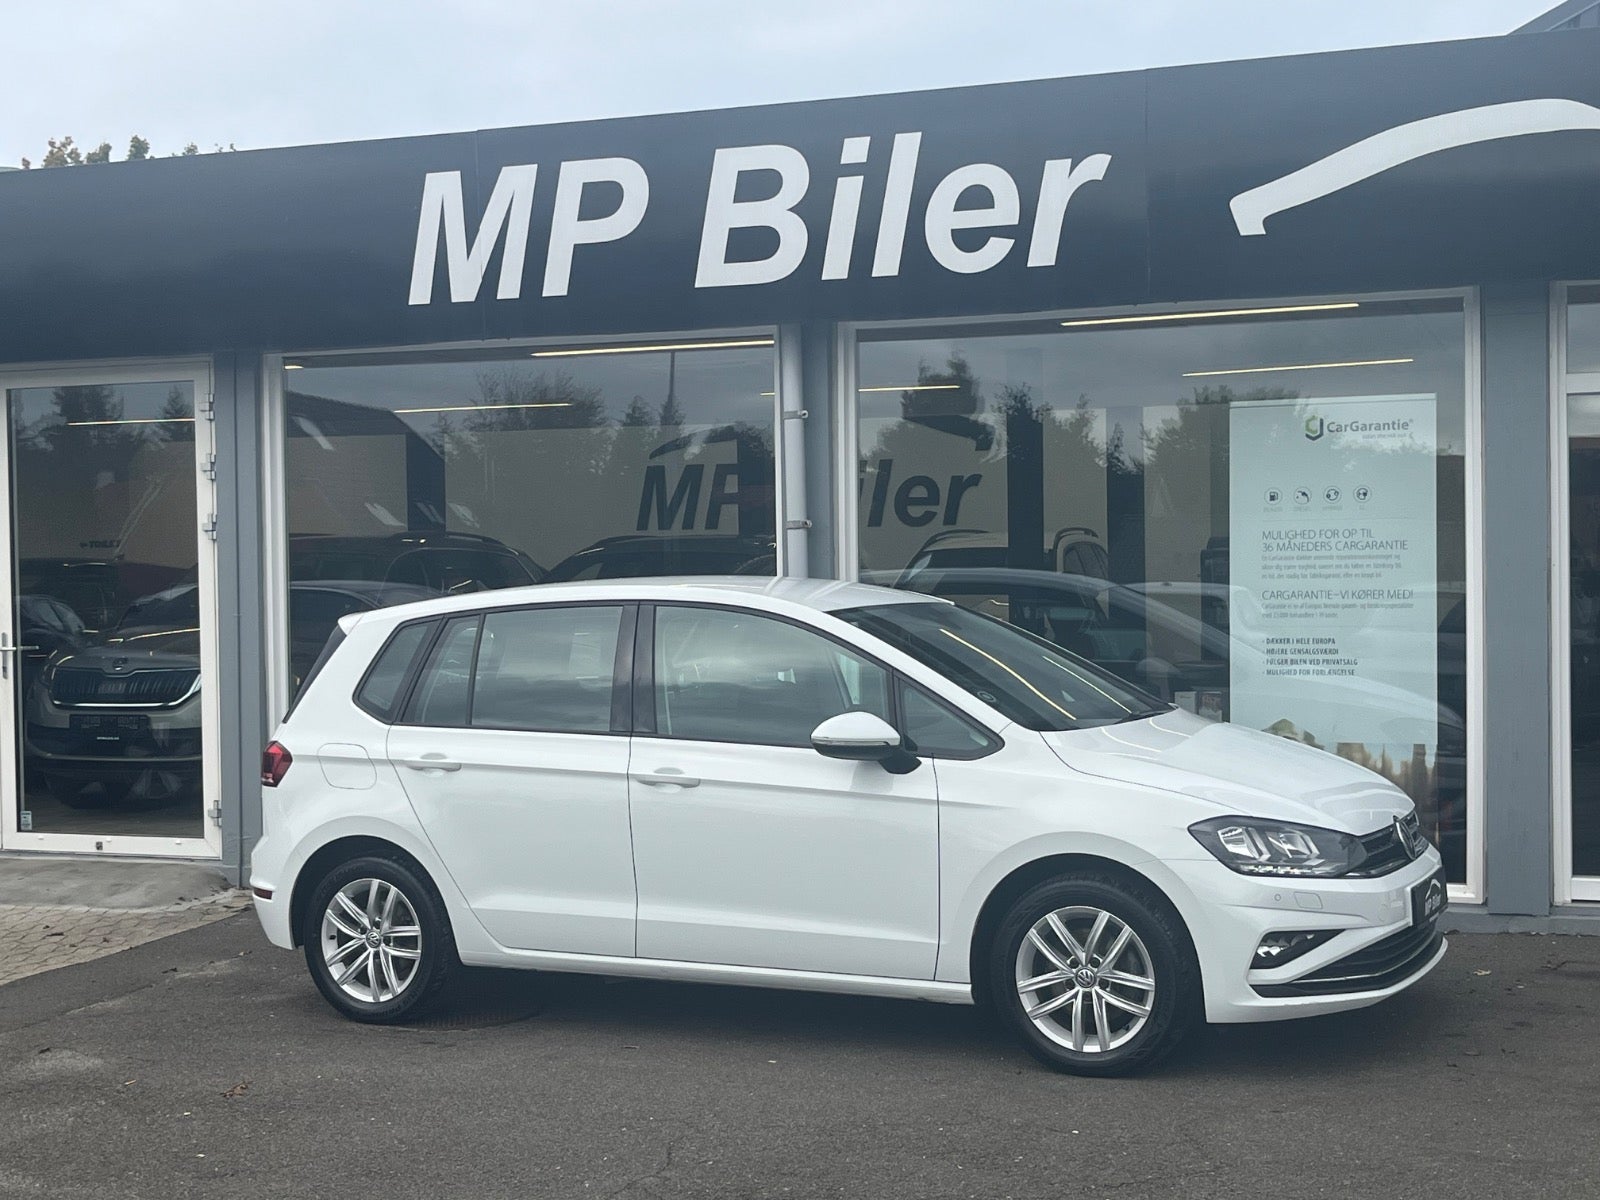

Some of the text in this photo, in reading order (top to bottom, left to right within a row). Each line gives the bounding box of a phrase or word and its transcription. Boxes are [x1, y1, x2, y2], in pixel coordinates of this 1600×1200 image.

[408, 131, 1112, 306] MP Biler
[860, 458, 983, 528] ler
[1262, 528, 1375, 541] MULIGHED FOR OP TIL
[1262, 539, 1409, 553] 36 MÅNEDERS CARGARANTIE
[1351, 589, 1384, 600] KØRER
[1312, 637, 1336, 645] EUROPA
[1321, 658, 1358, 666] PRIVATSALG
